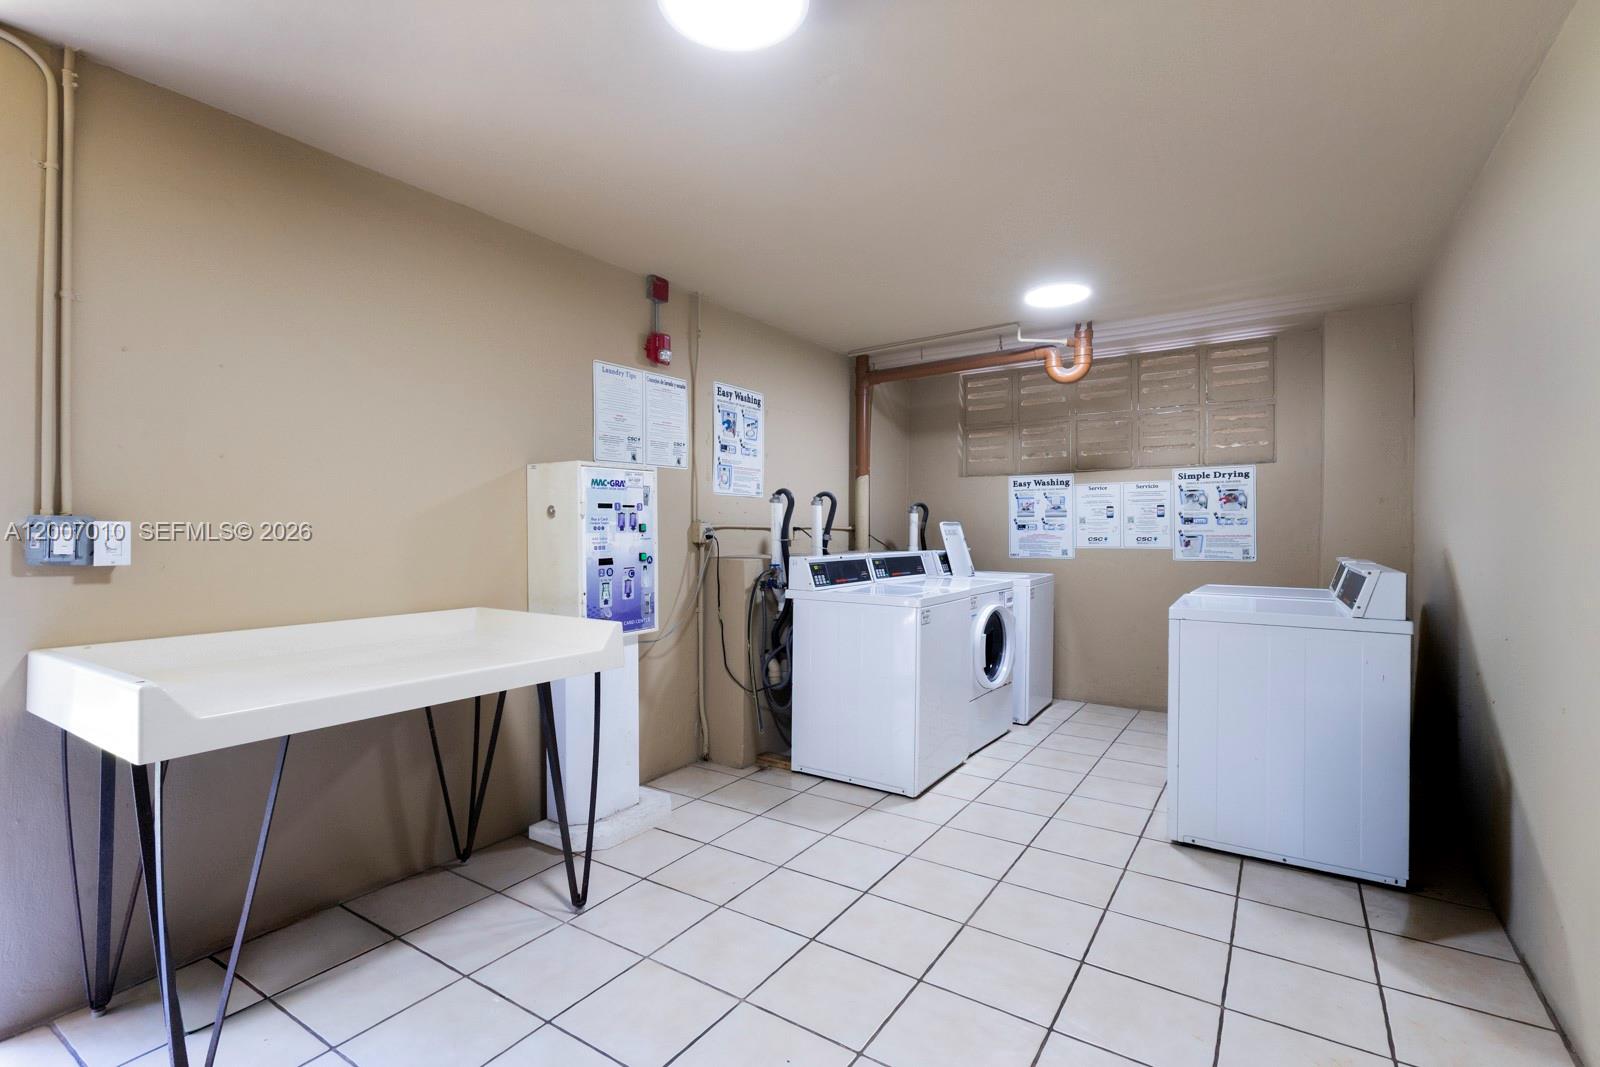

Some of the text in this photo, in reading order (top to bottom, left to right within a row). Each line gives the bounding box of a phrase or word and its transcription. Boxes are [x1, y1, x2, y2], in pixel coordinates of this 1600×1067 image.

[602, 366, 637, 380] Laundry Tips
[717, 386, 761, 408] Easy Washing
[1178, 470, 1250, 481] Simple Drying
[591, 478, 626, 488] MAC-GRA
[1034, 478, 1070, 488] Washing
